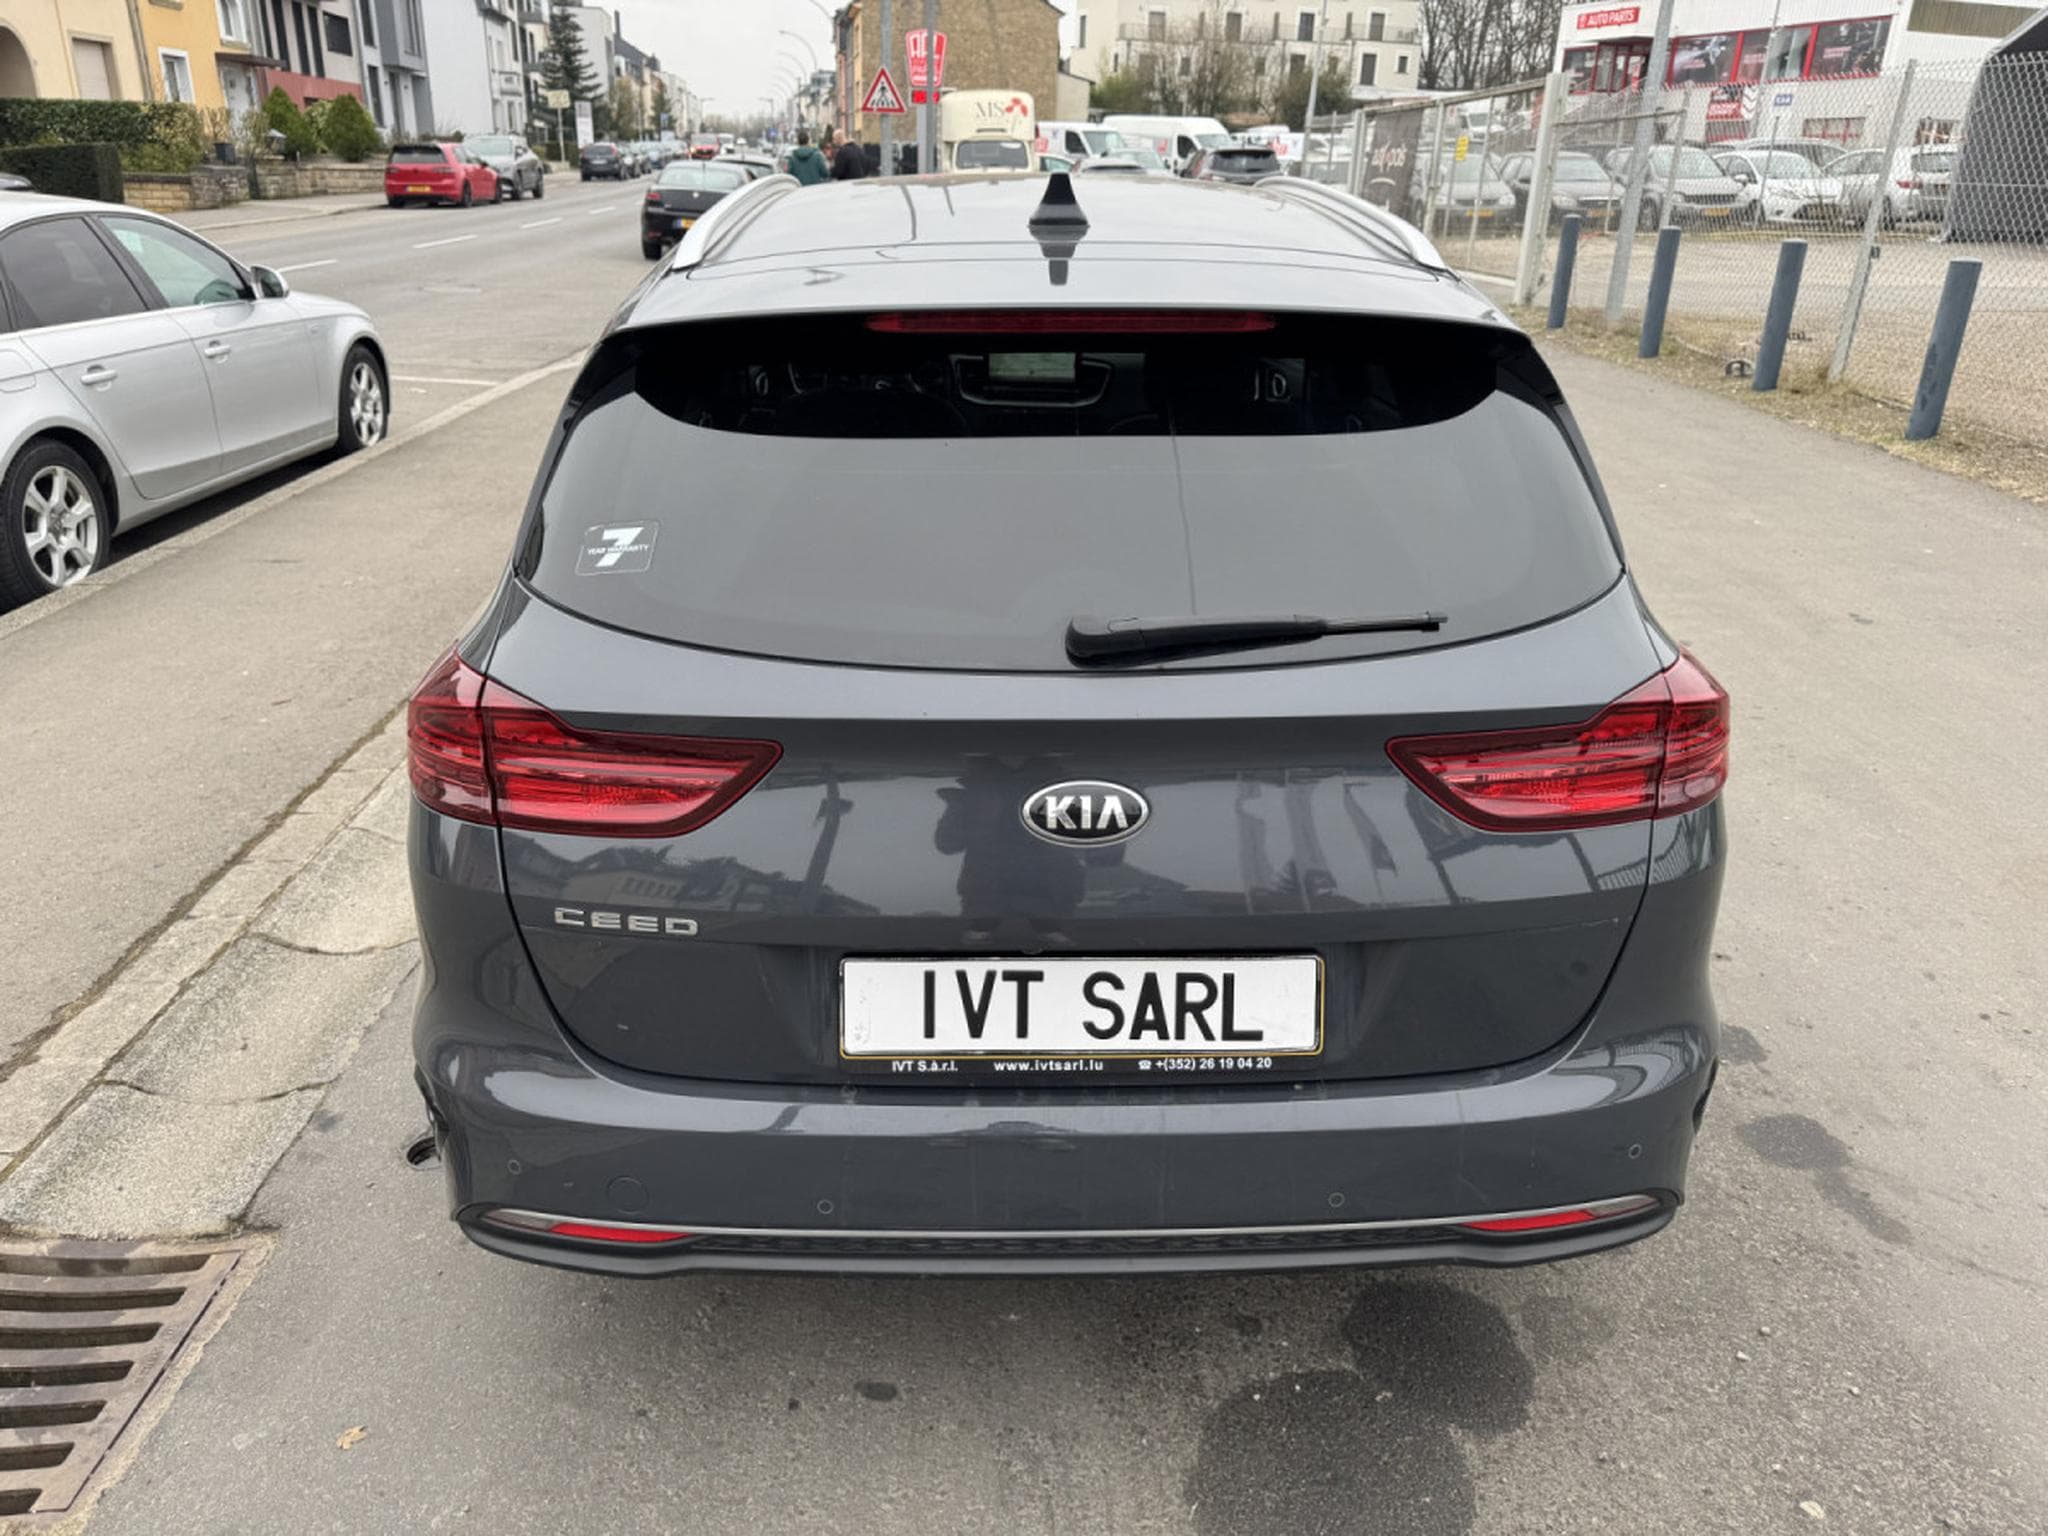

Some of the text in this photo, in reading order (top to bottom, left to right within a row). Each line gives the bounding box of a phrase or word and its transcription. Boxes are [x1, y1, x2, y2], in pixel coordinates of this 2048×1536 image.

[595, 526, 645, 567] 7
[1045, 795, 1129, 829] KIA
[554, 907, 699, 936] CEED
[1082, 971, 1263, 1041] SARL
[892, 1060, 914, 1072] IVT
[993, 1059, 1104, 1071] www.ivtsarl.lu
[1155, 1057, 1196, 1071] +(352)
[1200, 1058, 1215, 1069] 26
[1219, 1058, 1233, 1069] 19
[1237, 1058, 1252, 1069] 04
[1256, 1057, 1272, 1068] 20
